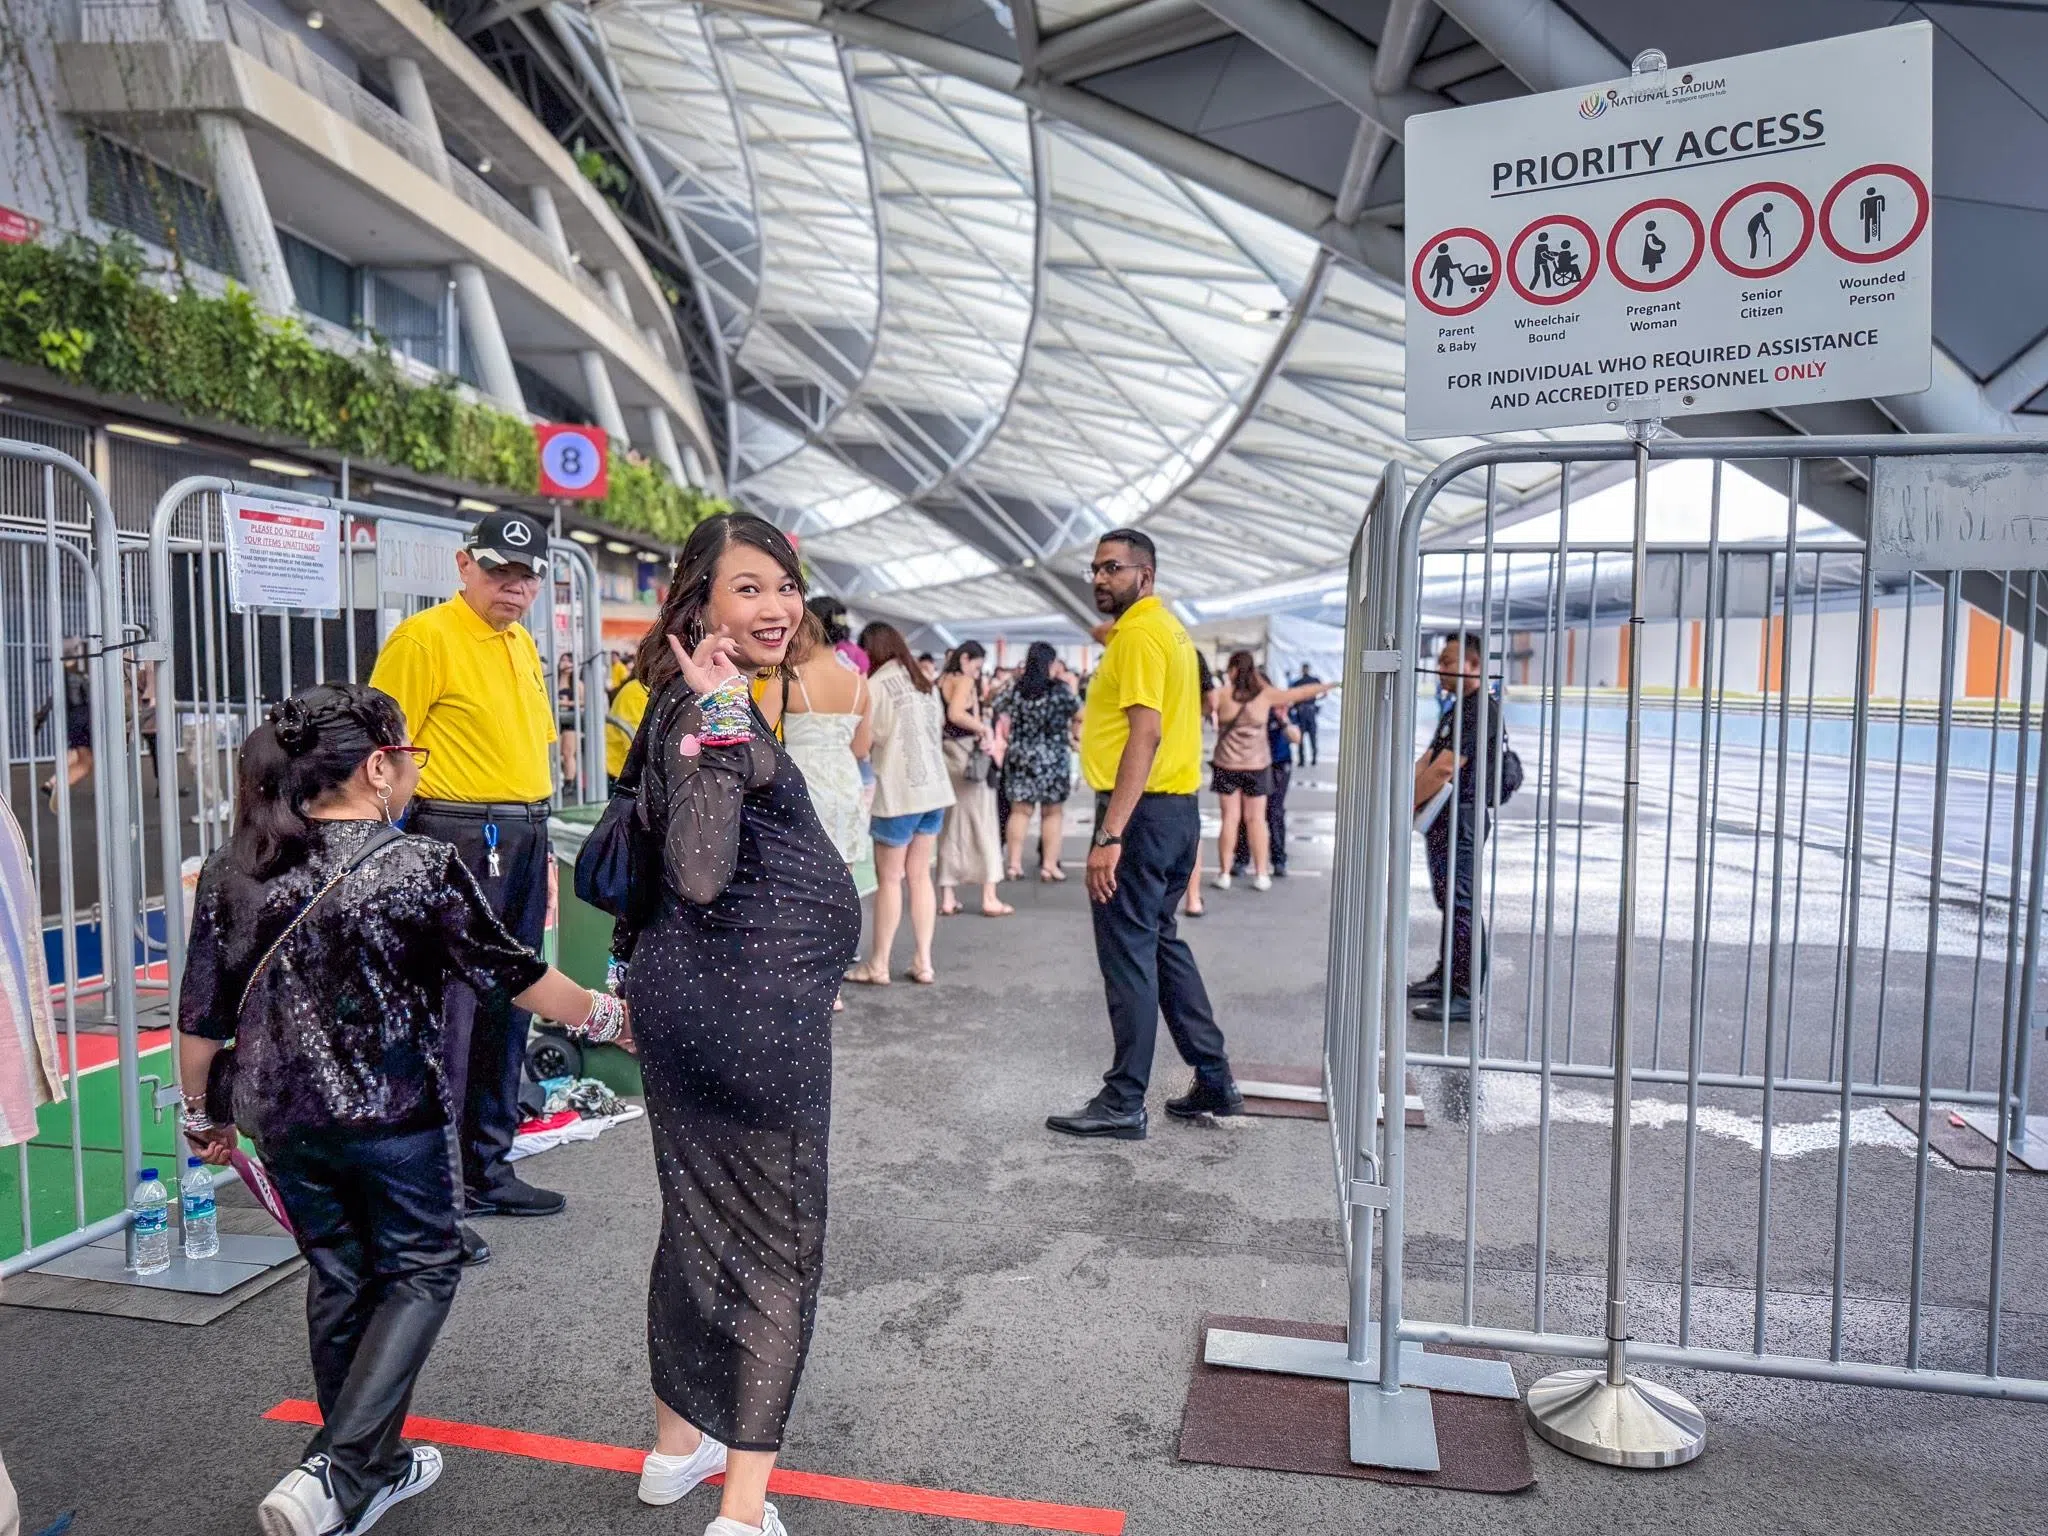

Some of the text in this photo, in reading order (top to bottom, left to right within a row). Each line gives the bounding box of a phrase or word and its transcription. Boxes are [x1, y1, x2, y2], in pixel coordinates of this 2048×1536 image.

[1611, 78, 1726, 108] NATIONAL STADIUM
[1493, 108, 1825, 191] PRIORITY ACCESS
[1839, 271, 1906, 290] Wounded
[1741, 289, 1783, 302] Senior
[1849, 292, 1895, 306] Person
[1626, 300, 1681, 316] Pregnant
[1740, 305, 1784, 319] Citizen
[1514, 312, 1581, 329] Wheelchair
[1630, 319, 1678, 332] Woman
[1438, 325, 1475, 338] Parent
[1528, 330, 1566, 344] Bound
[1436, 341, 1477, 354] & Baby
[1448, 329, 1879, 390] FOR INDIVIDUAL WHO REQUIRED ASSISTANCE
[1490, 361, 1827, 409] AND ACCREDITED PERSONNEL ONLY
[562, 446, 581, 475] 8
[250, 524, 315, 541] PLEASE DO NOT LEAVE
[244, 535, 321, 552] YOUR ITEMS UNATTENDED
